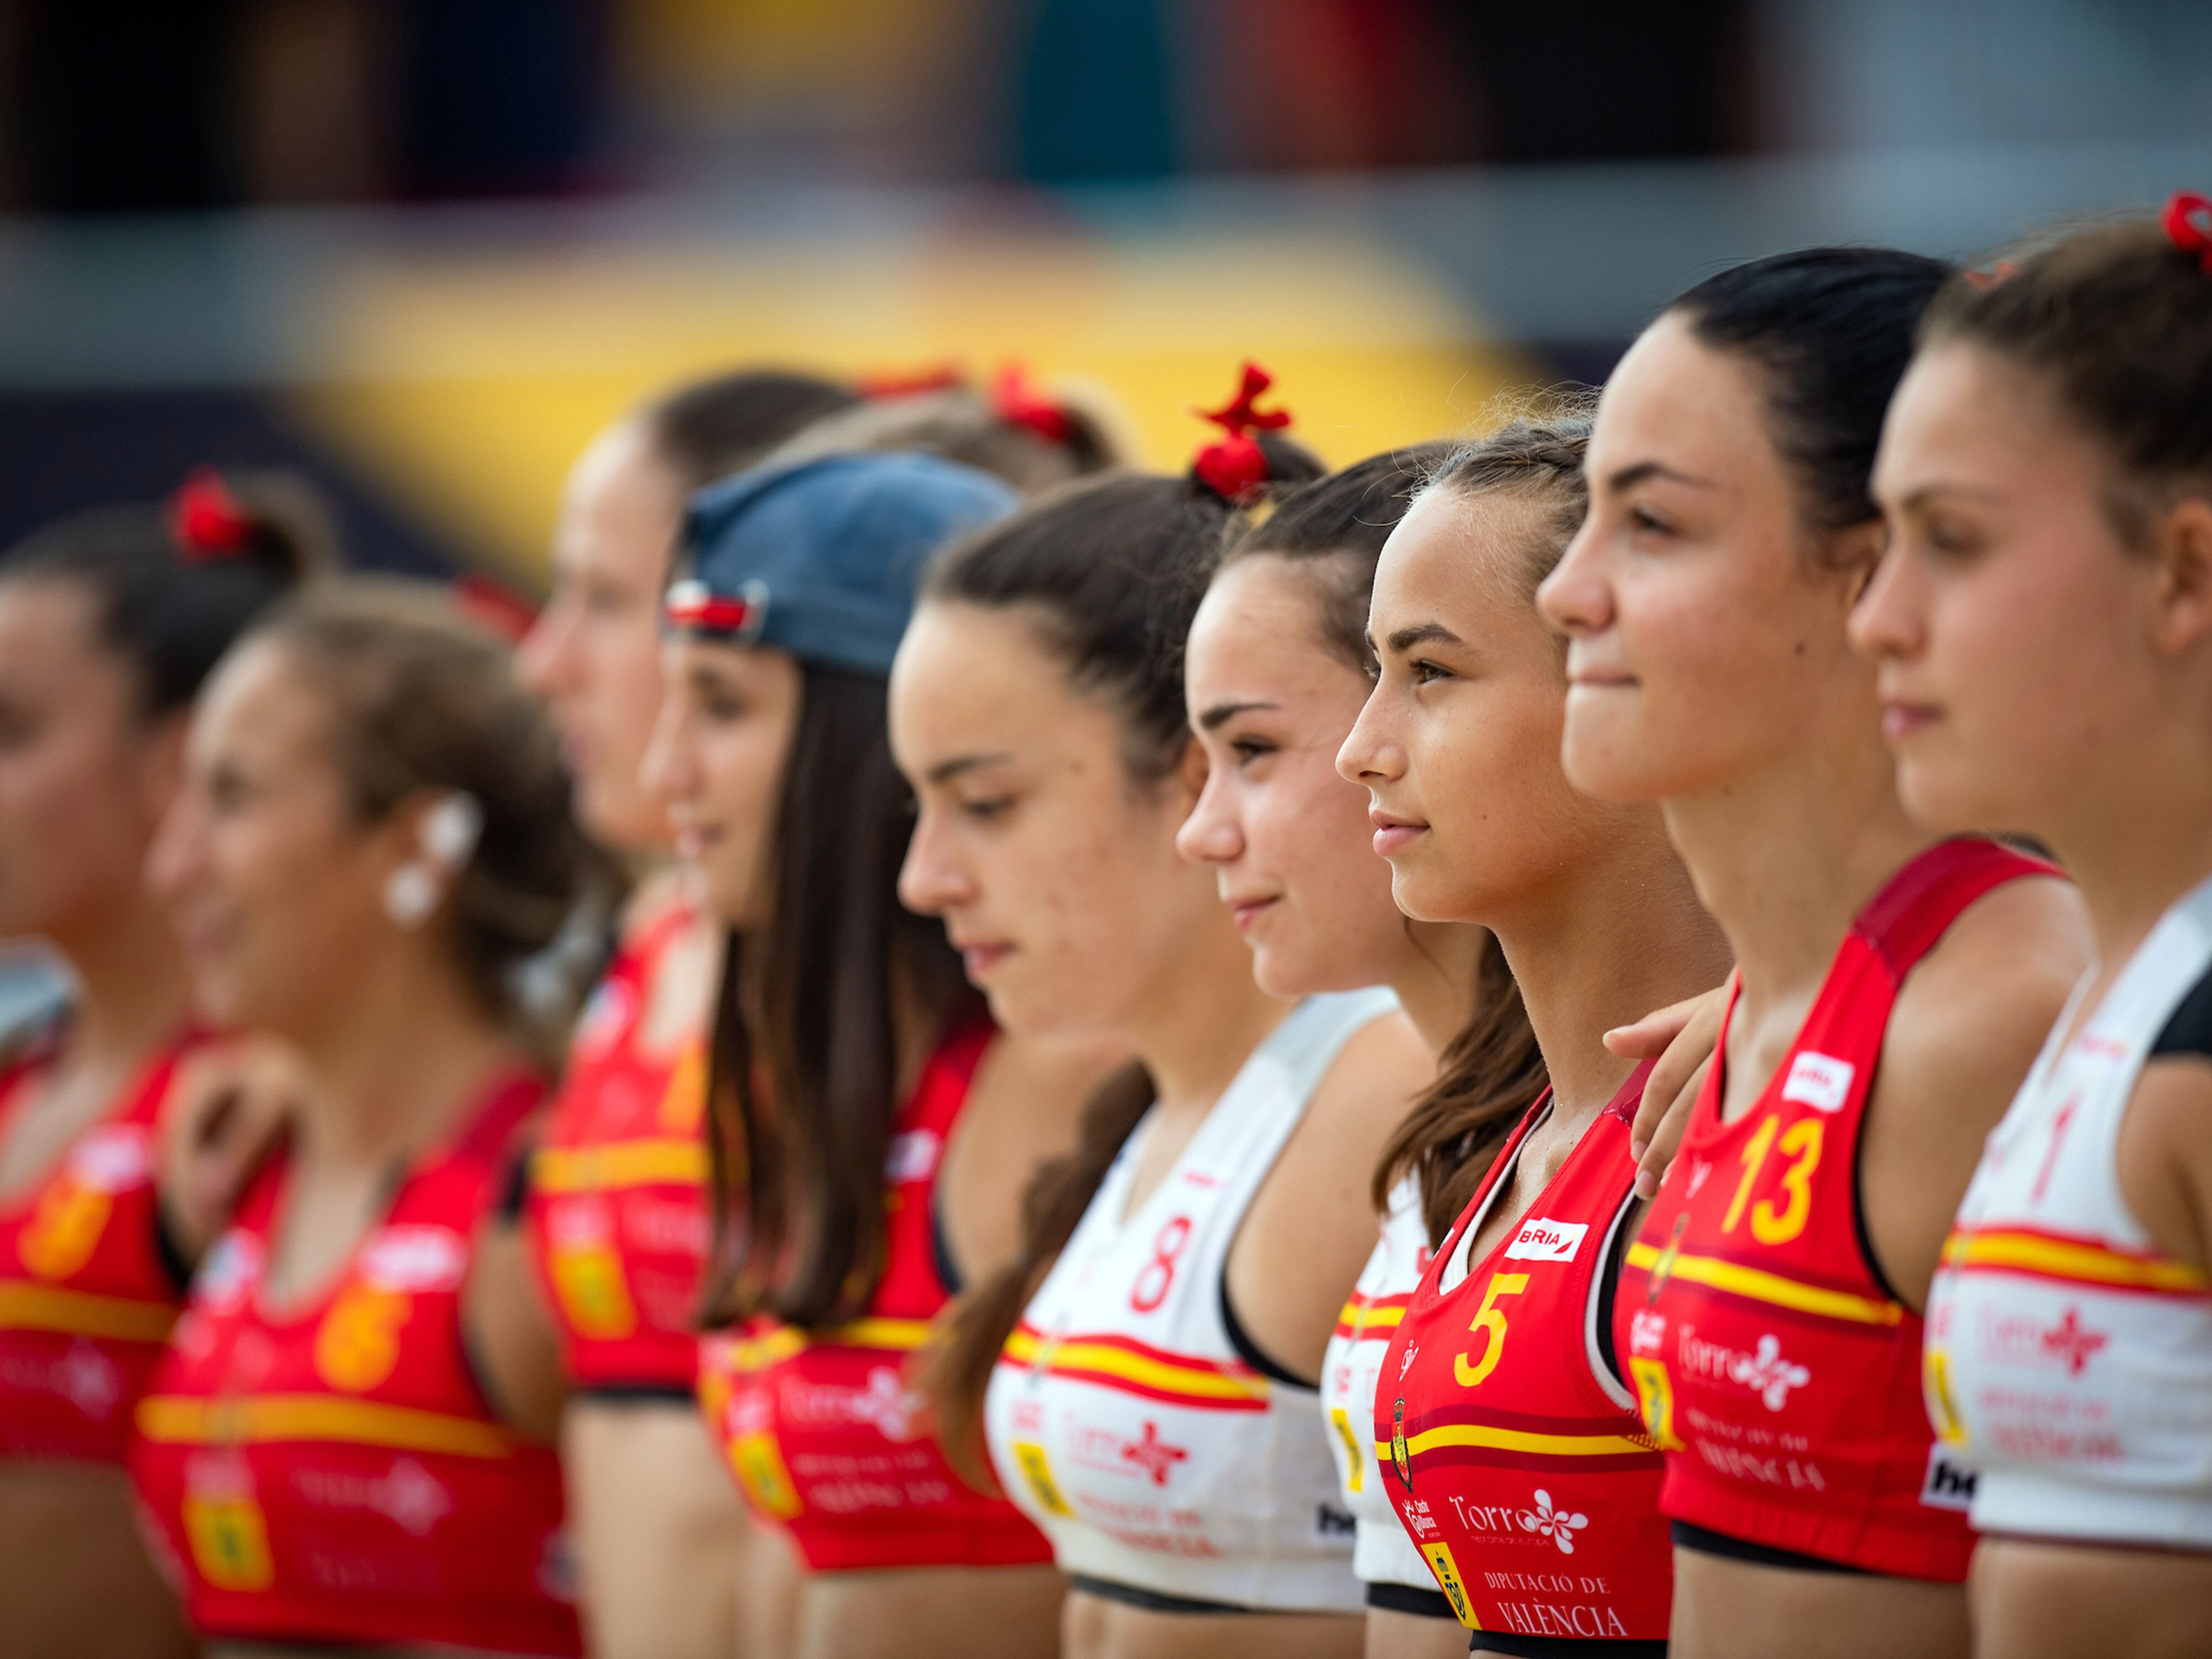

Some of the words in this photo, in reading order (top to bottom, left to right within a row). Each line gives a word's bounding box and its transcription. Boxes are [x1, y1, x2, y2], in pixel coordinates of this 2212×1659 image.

[1720, 1113, 1825, 1245] 13
[2028, 1083, 2083, 1207] 1
[1129, 1214, 1192, 1314] 8
[1454, 1272, 1531, 1387] 5
[1484, 1571, 1574, 1593] DIPUTACIÓ
[1579, 1577, 1611, 1594] DE
[1497, 1597, 1628, 1637] VALÈNCIA
